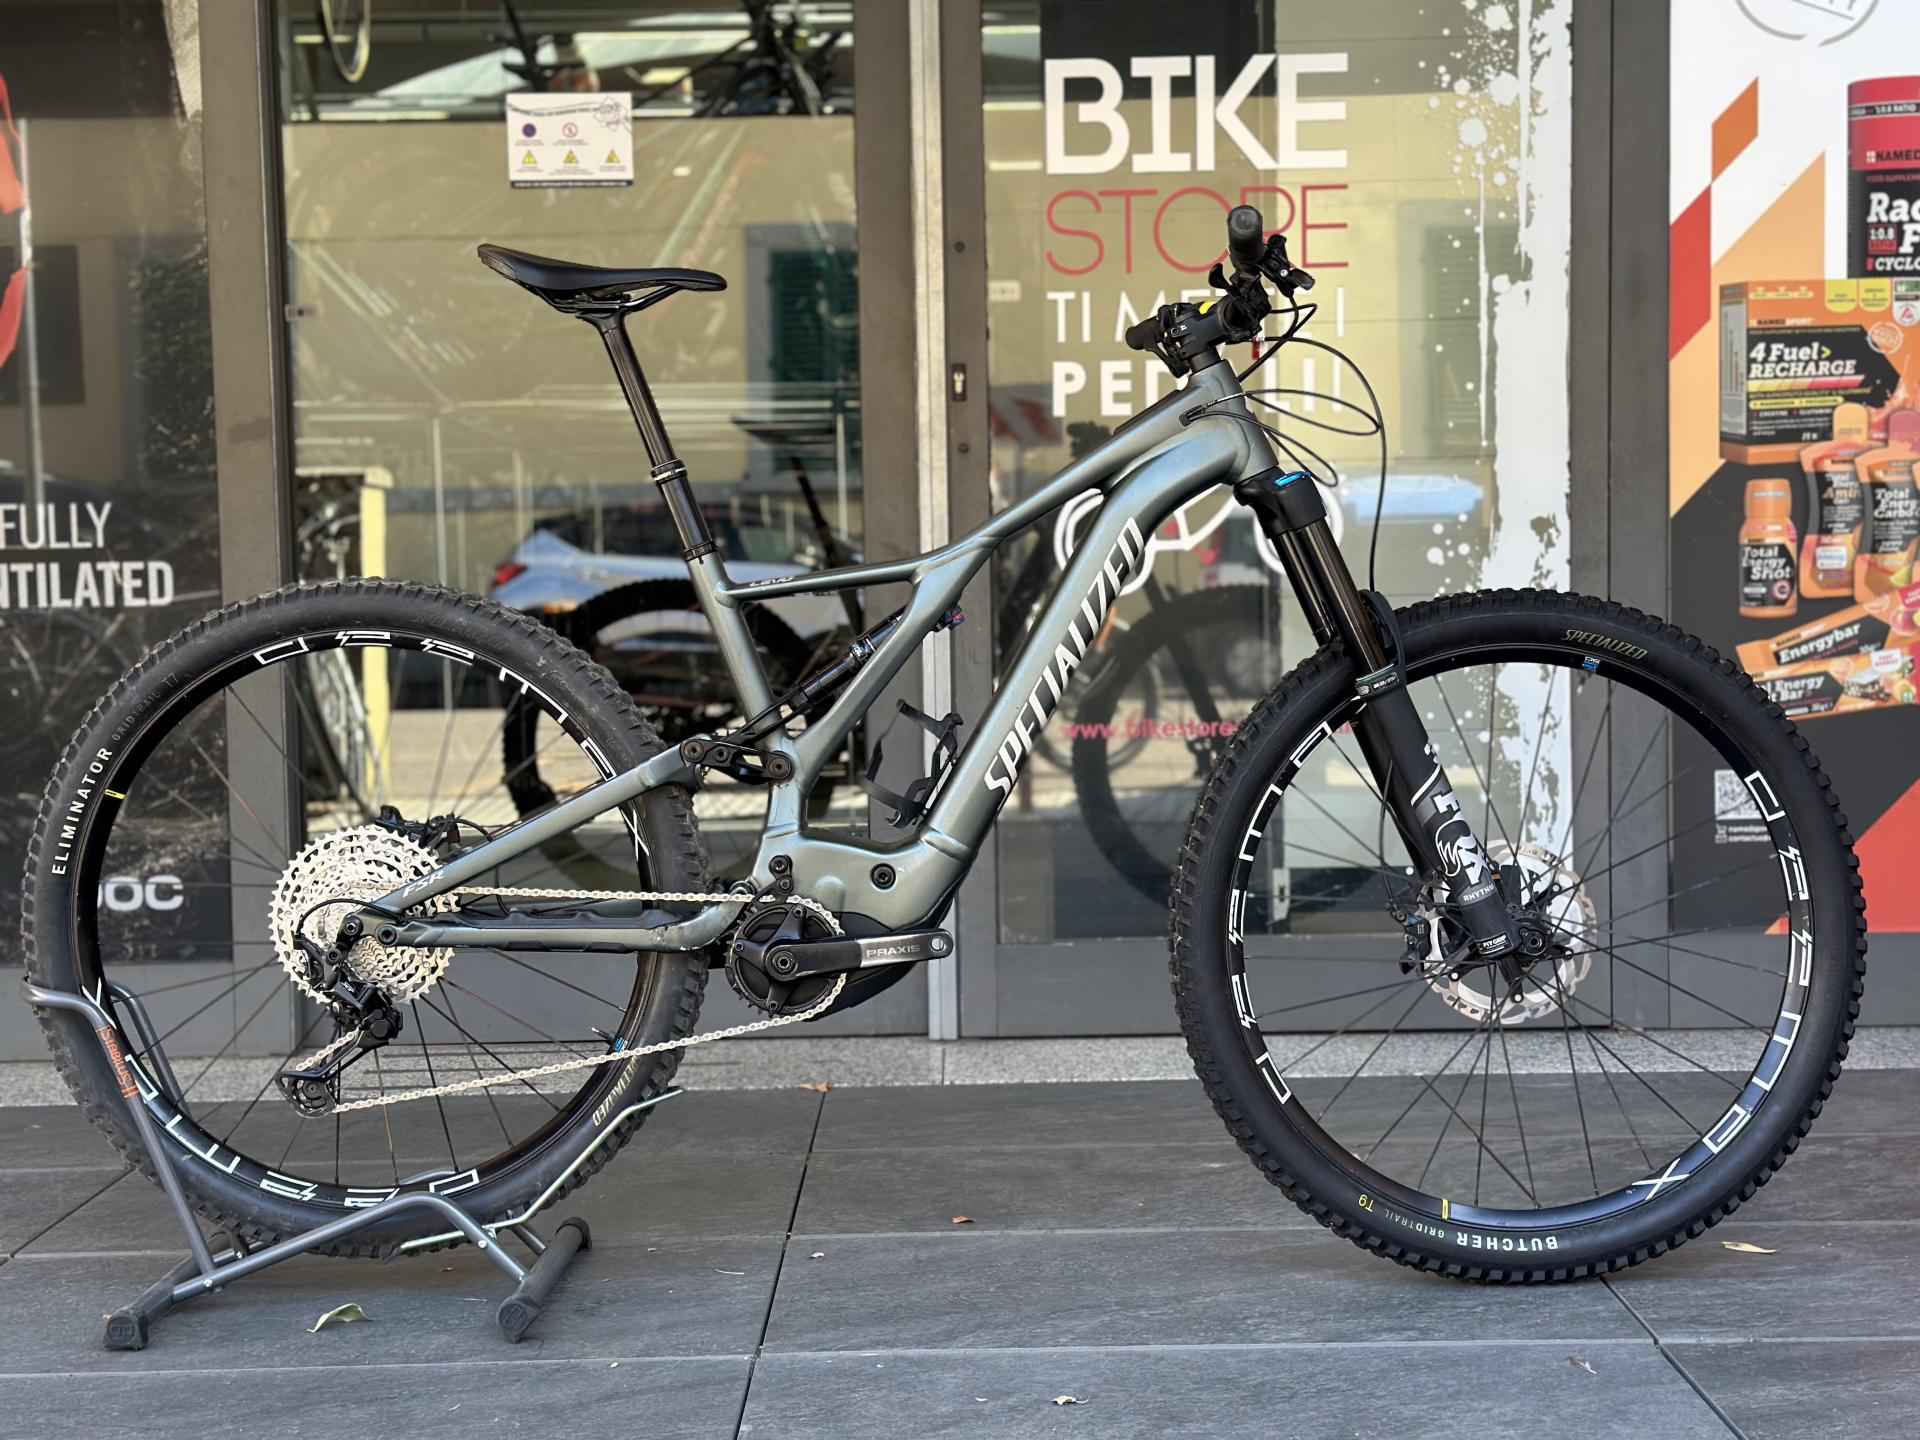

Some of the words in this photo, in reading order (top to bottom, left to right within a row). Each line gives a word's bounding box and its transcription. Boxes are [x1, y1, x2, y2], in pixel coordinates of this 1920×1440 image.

[1045, 53, 1349, 174] BIKE
[1047, 290, 1091, 343] TI
[1749, 341, 1767, 362] 4
[1748, 359, 1857, 379] RECHARGE
[1873, 487, 1911, 501] Total
[0, 501, 112, 550] FULLY
[1742, 546, 1780, 559] Total
[1741, 557, 1787, 571] Energy
[1749, 565, 1792, 580] Shot
[1562, 628, 1649, 661] SPECIALIZED
[1779, 623, 1862, 664] Energybar
[984, 516, 1145, 800] SPECIALIZED
[1774, 675, 1825, 692] Energy
[1779, 689, 1805, 702] Bar
[52, 747, 113, 875] ELIMINATOR
[1434, 788, 1490, 886] FOX
[97, 873, 184, 912] OC
[401, 869, 446, 899] FSR
[1462, 882, 1496, 902] RHYTHM
[866, 944, 921, 958] PRAXIS
[1357, 1193, 1375, 1213] T9
[1456, 1230, 1560, 1252] BUTCHER
